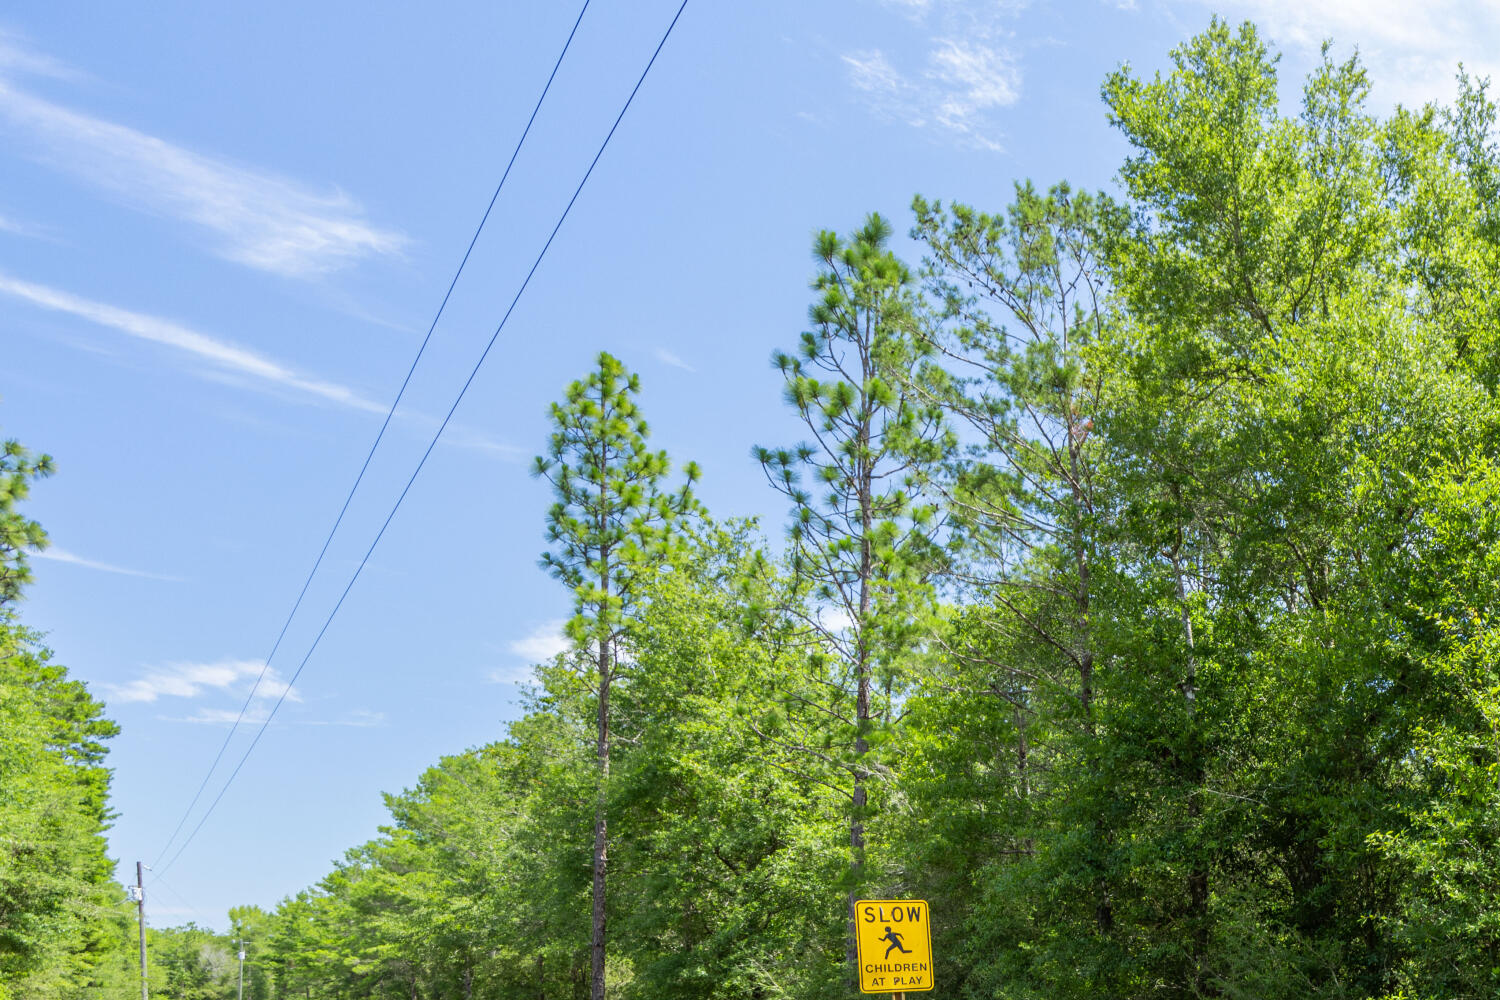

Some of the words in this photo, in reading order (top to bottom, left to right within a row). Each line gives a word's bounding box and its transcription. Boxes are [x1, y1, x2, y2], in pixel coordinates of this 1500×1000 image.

[864, 906, 921, 923] SLOW
[865, 963, 927, 973] CHILDREN
[871, 977, 886, 986] AT
[893, 976, 923, 985] PLAY
